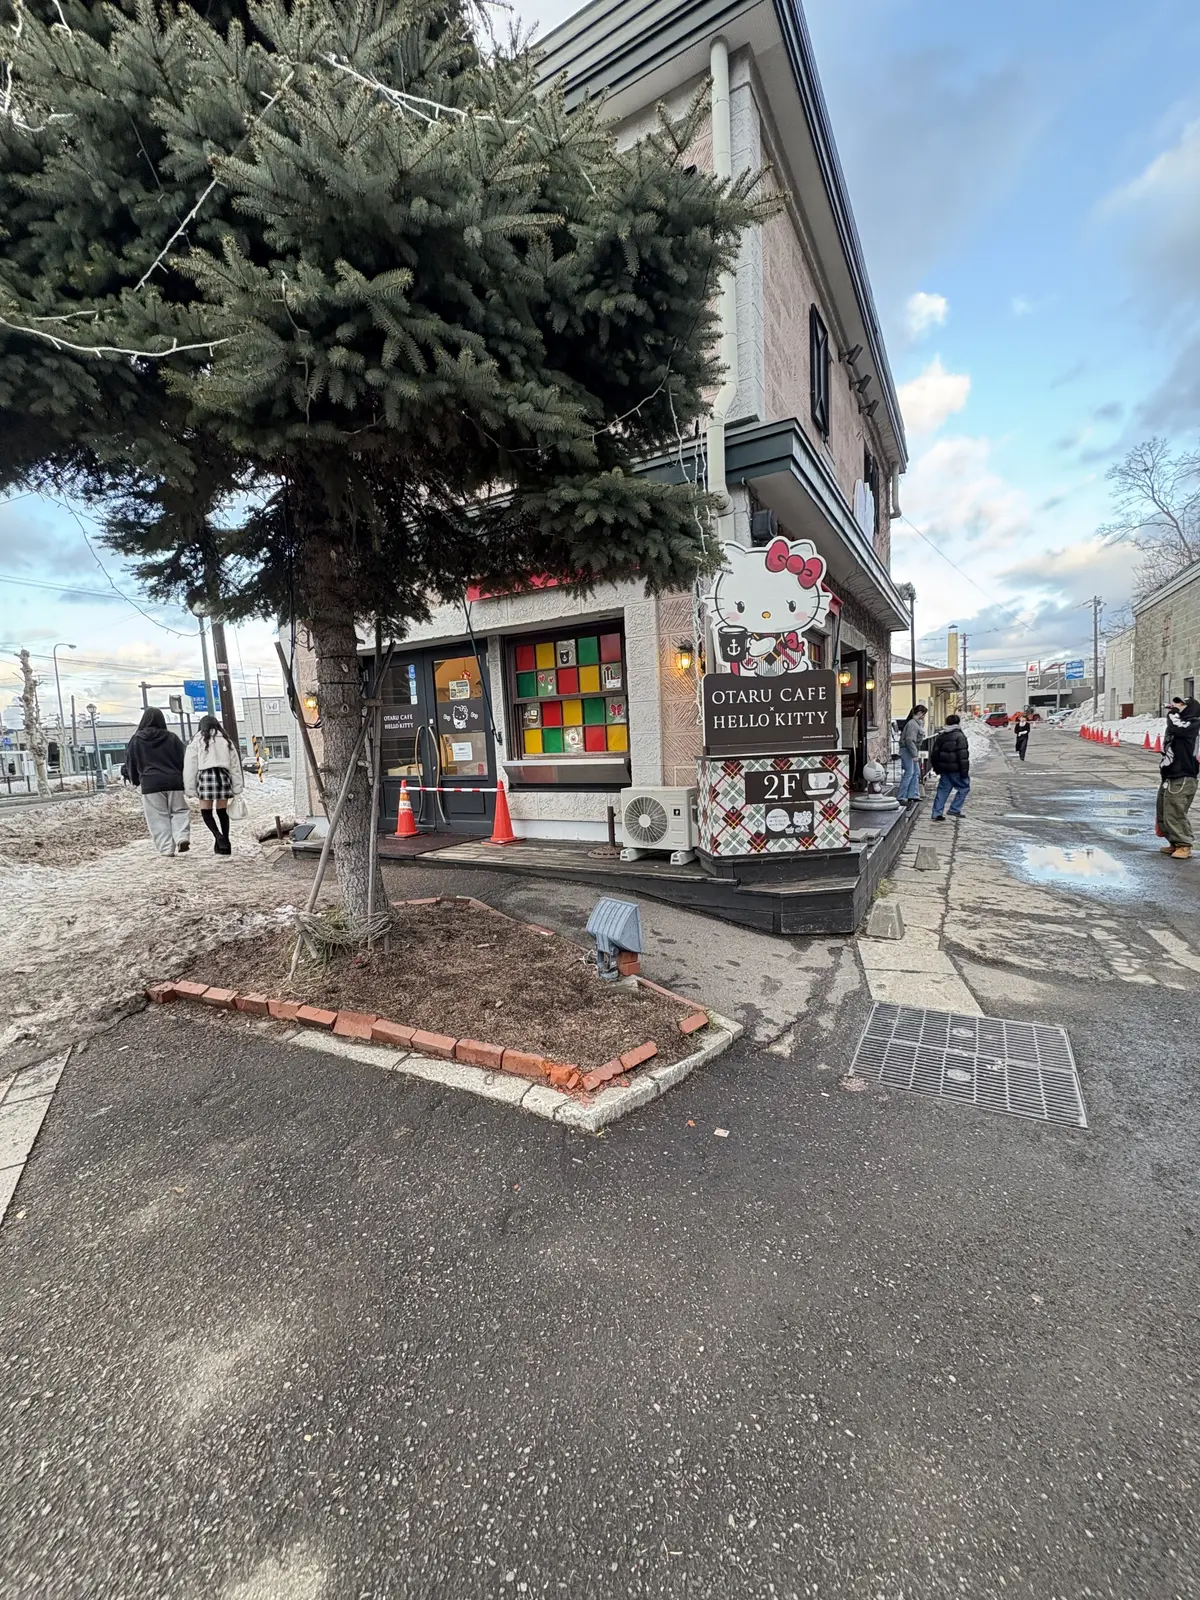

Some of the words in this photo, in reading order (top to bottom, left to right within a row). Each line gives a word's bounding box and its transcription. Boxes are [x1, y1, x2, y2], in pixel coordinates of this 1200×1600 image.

[711, 688, 773, 704] OTARU
[780, 687, 827, 702] CAFE
[713, 713, 770, 729] HELLO
[775, 711, 829, 726] KITTY
[764, 773, 800, 800] 2F
